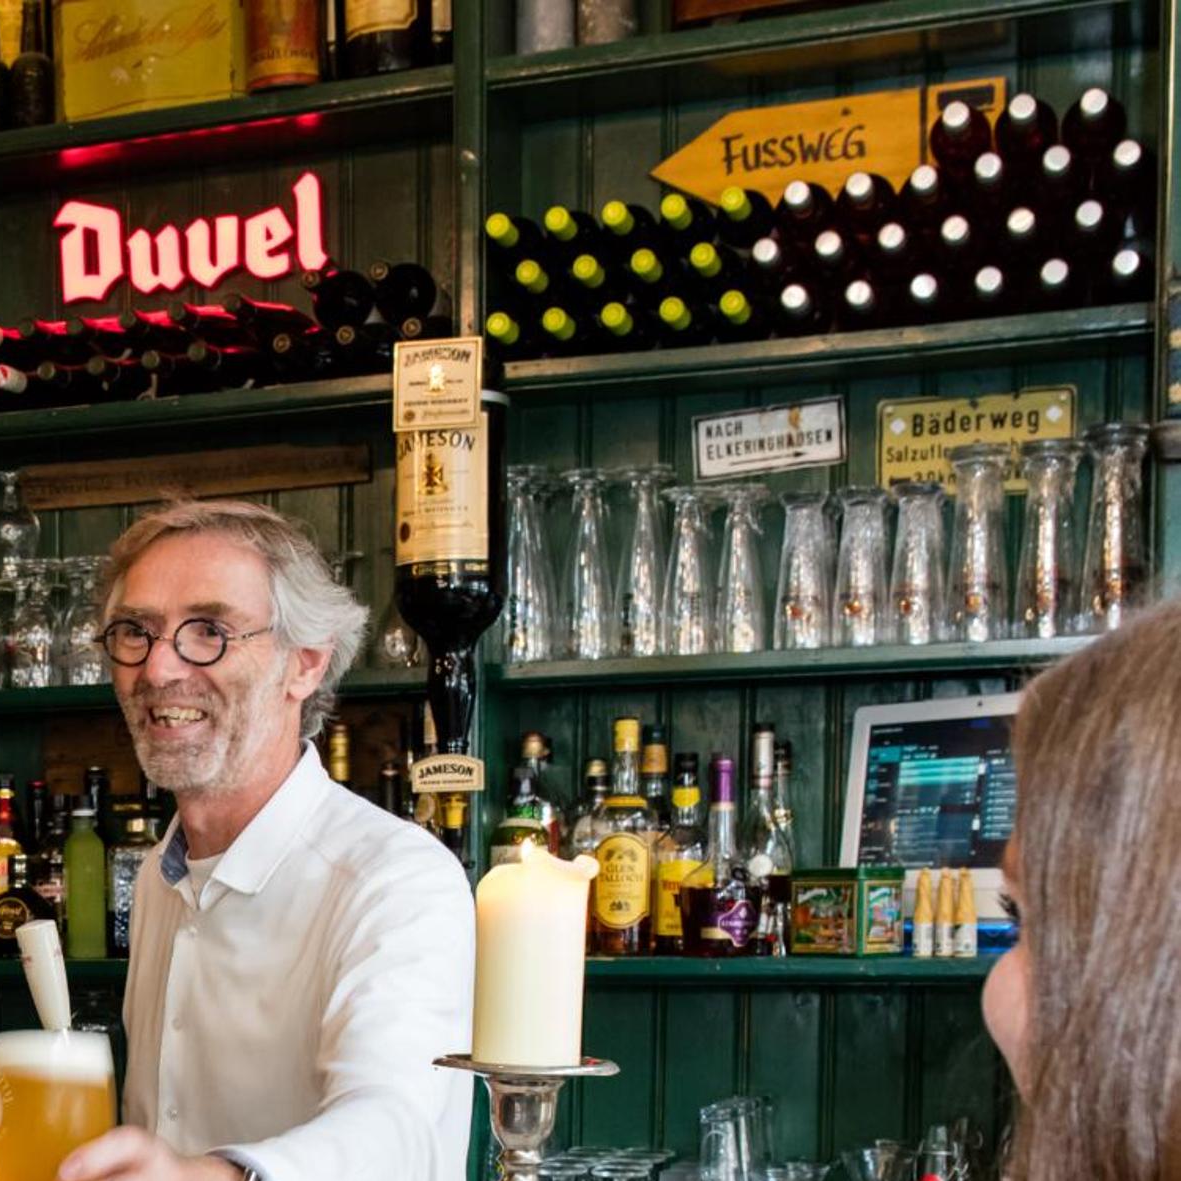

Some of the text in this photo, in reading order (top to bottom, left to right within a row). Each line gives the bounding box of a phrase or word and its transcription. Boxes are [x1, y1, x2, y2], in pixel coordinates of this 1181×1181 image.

[53, 171, 328, 304] Duvel
[911, 410, 1040, 438] Bäderweg
[418, 763, 474, 779] JAMESON
